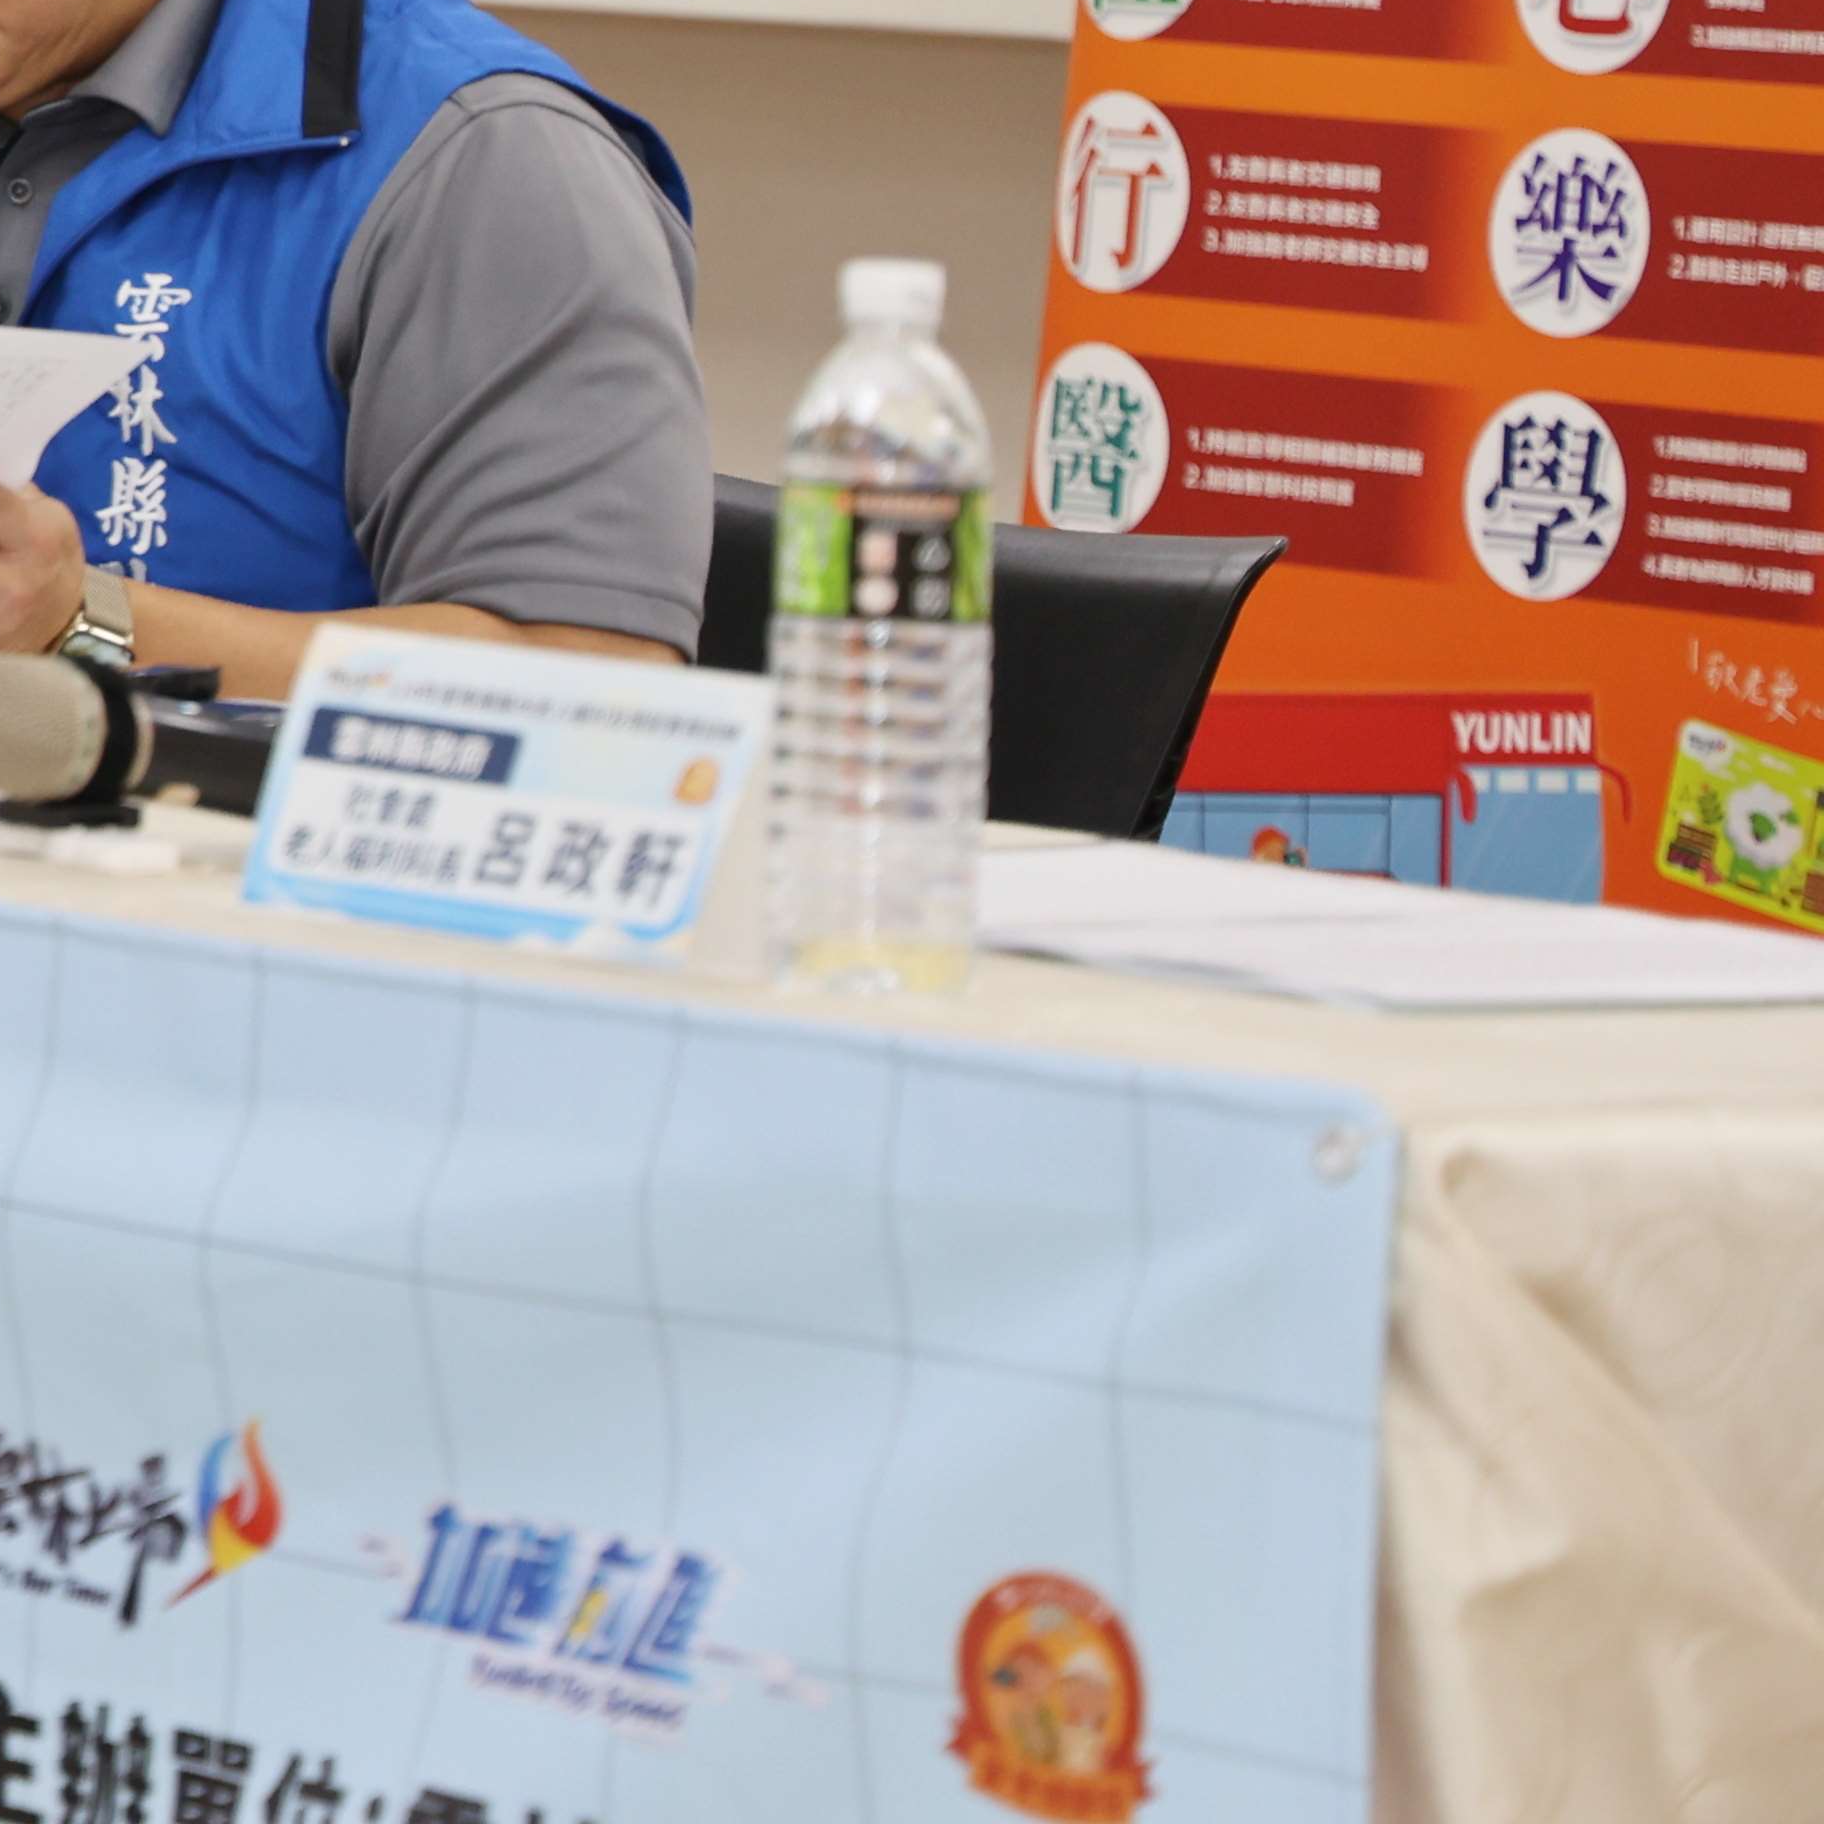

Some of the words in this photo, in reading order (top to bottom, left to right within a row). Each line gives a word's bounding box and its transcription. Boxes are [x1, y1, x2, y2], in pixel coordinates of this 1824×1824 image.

[1068, 115, 1165, 269] 行
[1511, 152, 1630, 303] 樂
[95, 272, 192, 583] 雲林縣
[1051, 376, 1146, 521] 醫
[1482, 413, 1611, 579] 學
[1452, 712, 1591, 755] YUNLIN
